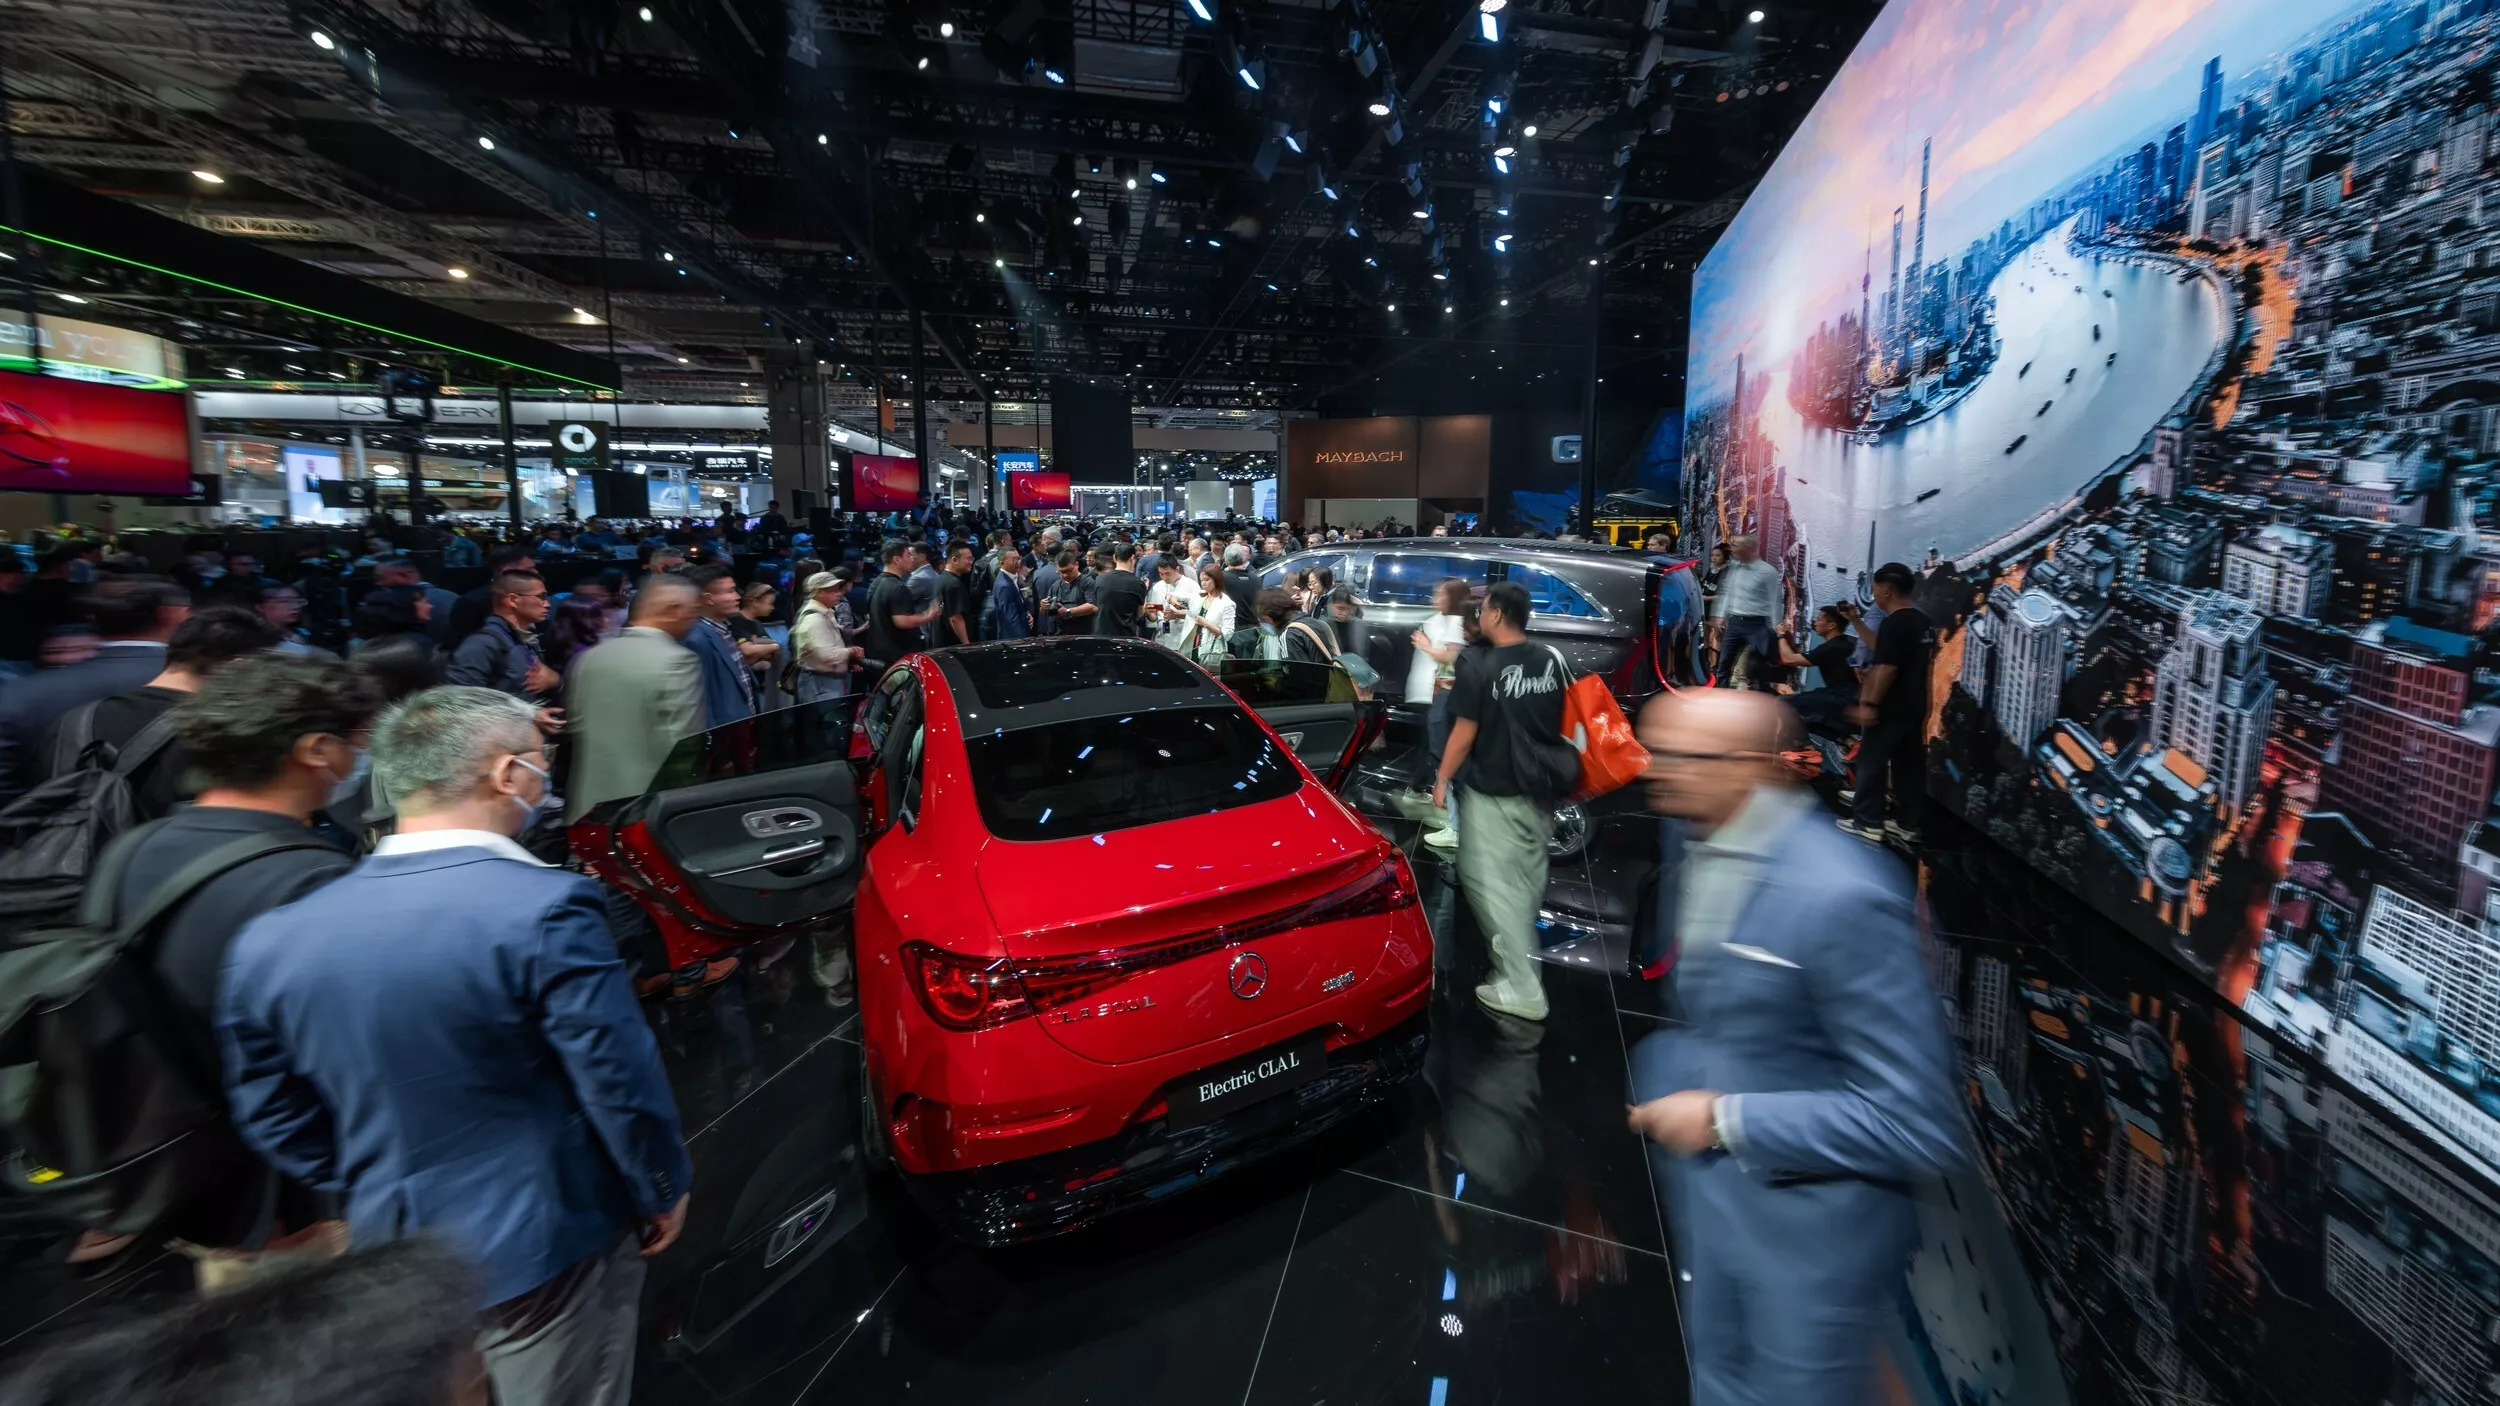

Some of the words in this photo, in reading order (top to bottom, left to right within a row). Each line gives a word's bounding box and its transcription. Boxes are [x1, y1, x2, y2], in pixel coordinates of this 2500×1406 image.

[1315, 450, 1404, 463] MAYBACH
[1198, 1070, 1256, 1103] Electric
[1258, 1056, 1289, 1079] CLA
[1288, 1051, 1300, 1069] L
